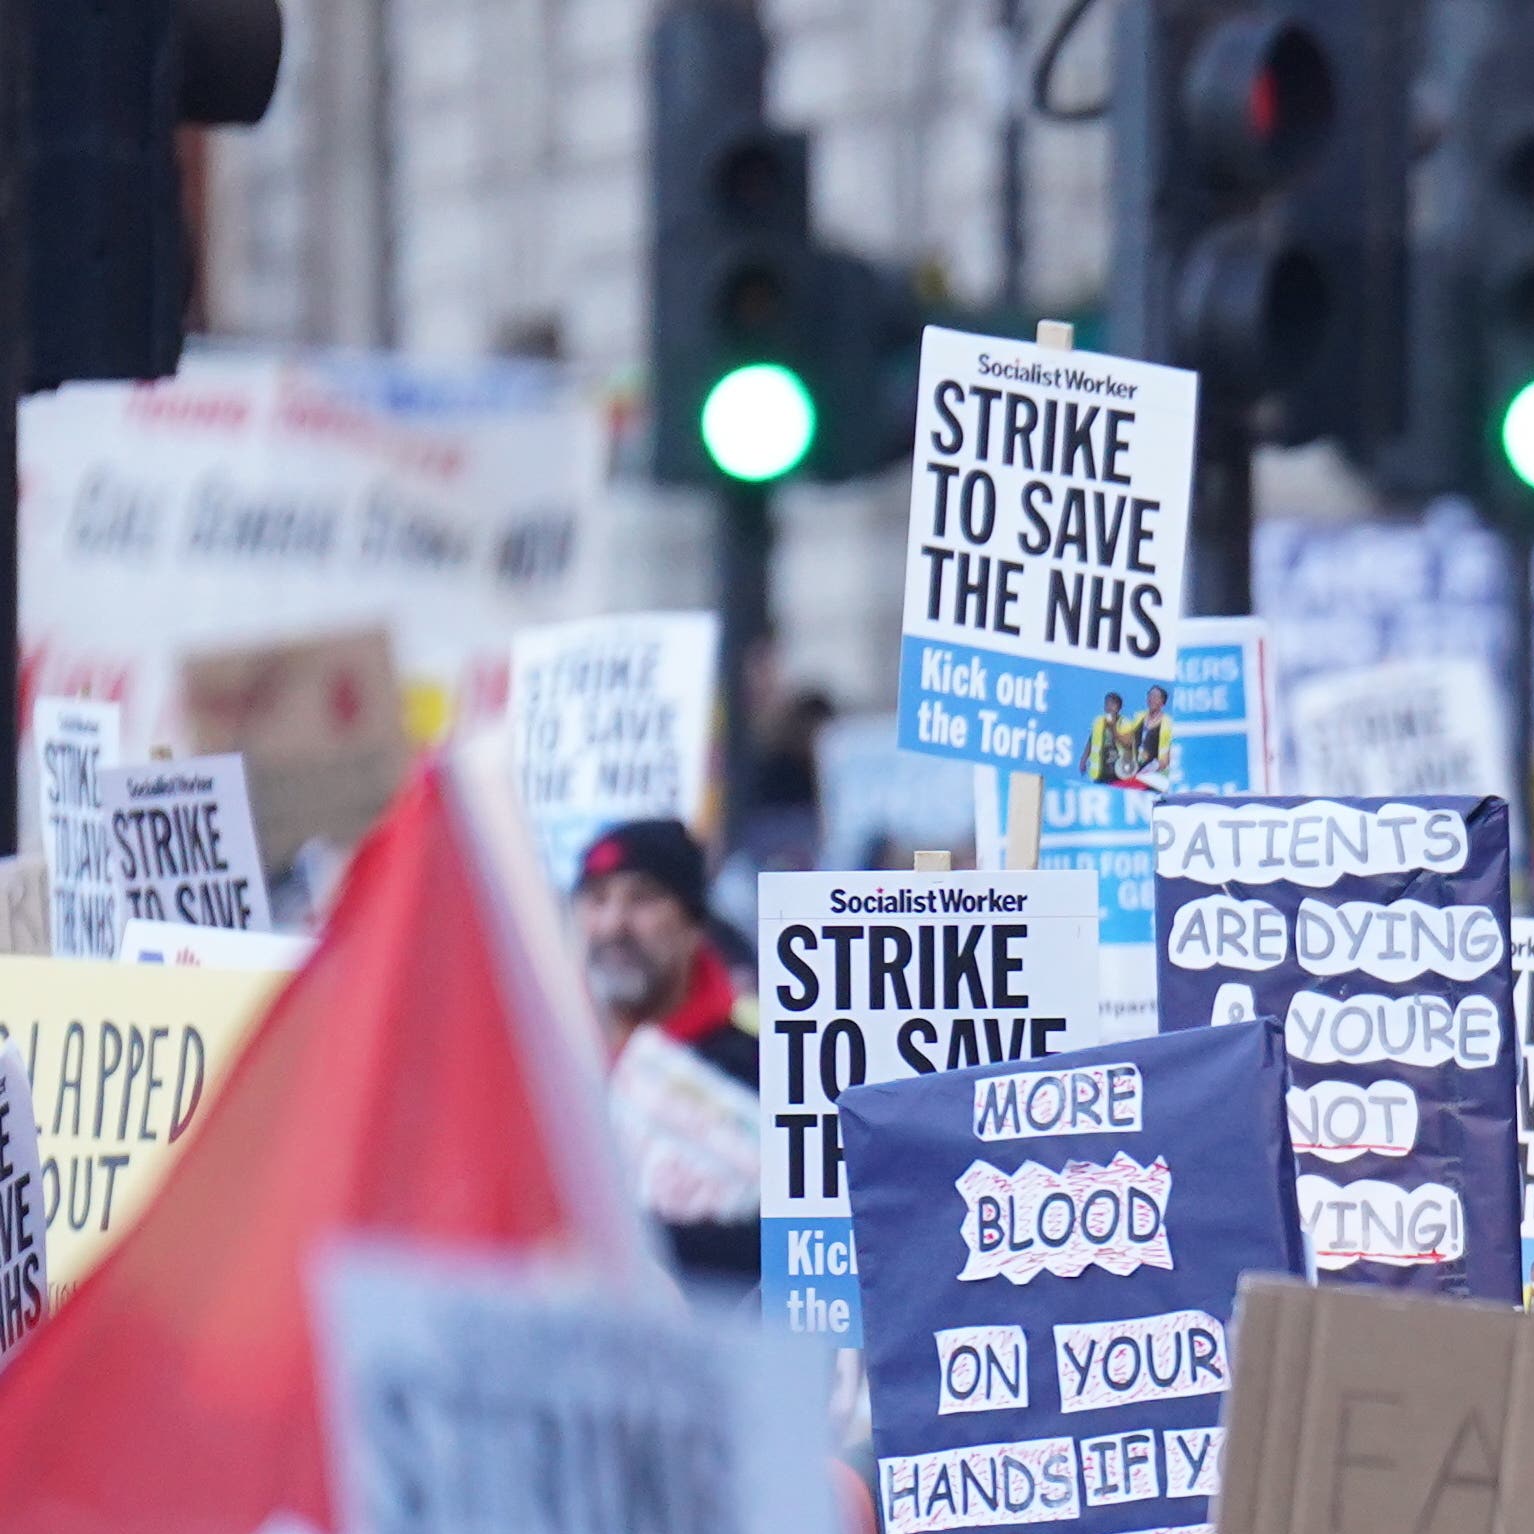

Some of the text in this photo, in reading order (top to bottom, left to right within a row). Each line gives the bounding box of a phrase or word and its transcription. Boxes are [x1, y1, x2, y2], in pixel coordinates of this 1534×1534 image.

[978, 353, 1138, 401] Socialist Worker
[930, 379, 1134, 485] STRIKE
[926, 463, 1161, 574] TO SAVE
[921, 546, 1024, 635] THE
[1044, 569, 1162, 660] NHS
[921, 648, 1049, 714] Kick out
[918, 699, 1073, 767] the Tories
[112, 802, 229, 881] STRIKE
[1153, 813, 1461, 870] PATIENTS
[830, 887, 1028, 914] Socialist Worker
[775, 924, 1030, 1012] STRIKE
[1177, 908, 1499, 963] ARE DYING
[2, 1020, 206, 1145] LAPPED
[775, 1018, 867, 1106] TO
[977, 1067, 1136, 1135] MORE
[1290, 1095, 1408, 1146] NOT
[787, 1230, 858, 1277] Kic
[978, 1187, 1161, 1252] BLOOD
[787, 1288, 851, 1336] the
[946, 1327, 1223, 1401] ON YOUR
[886, 1453, 1073, 1522] HANDS
[1088, 1434, 1151, 1497] IF
